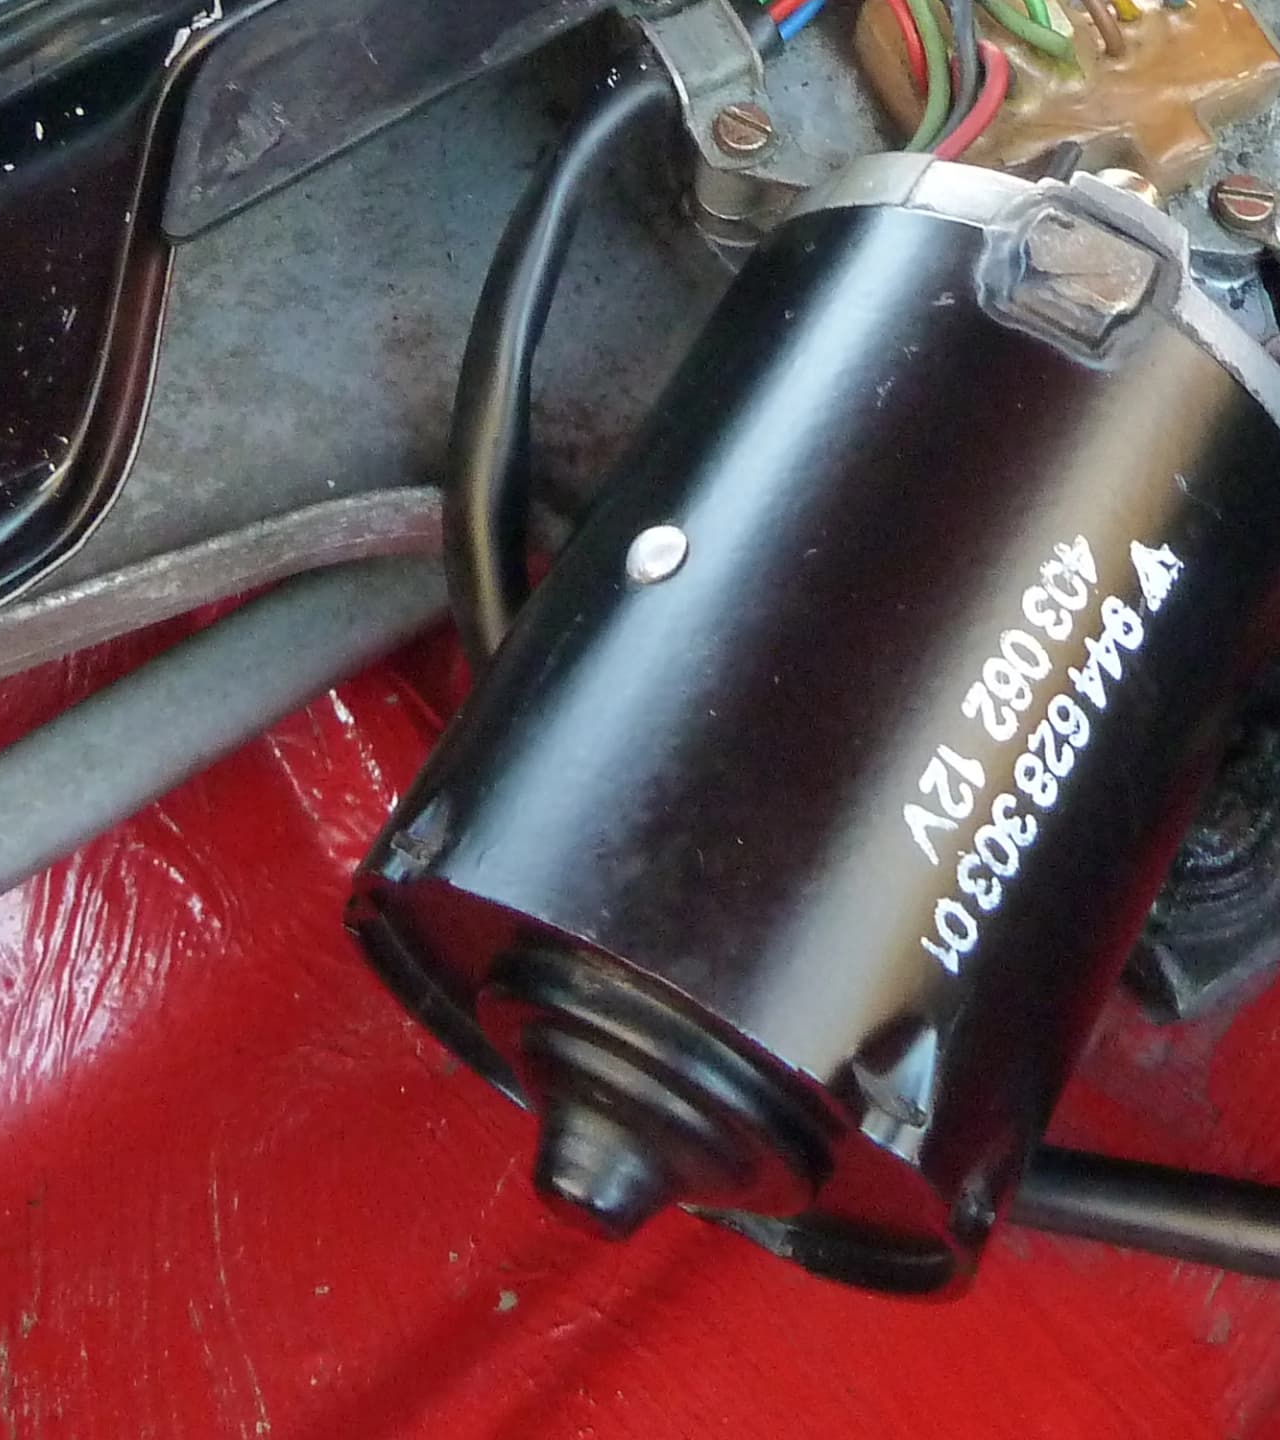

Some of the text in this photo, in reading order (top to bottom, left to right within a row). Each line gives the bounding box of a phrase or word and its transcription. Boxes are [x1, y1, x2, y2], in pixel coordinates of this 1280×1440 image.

[903, 534, 1098, 866] 403 062 12V
[920, 595, 1145, 976] 944 628 303 01
